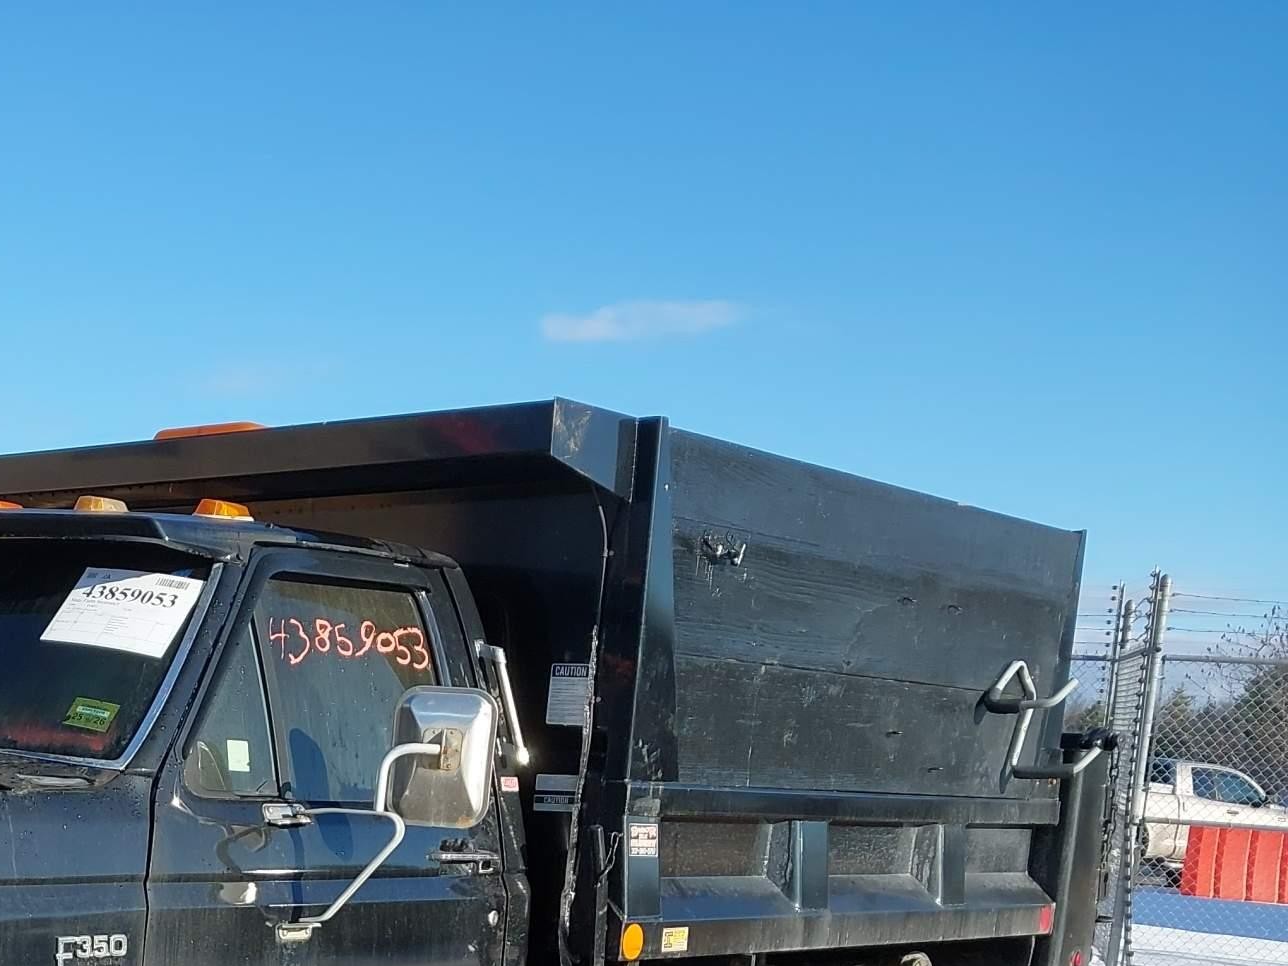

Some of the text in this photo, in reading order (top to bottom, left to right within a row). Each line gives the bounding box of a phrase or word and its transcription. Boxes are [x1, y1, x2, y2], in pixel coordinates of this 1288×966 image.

[82, 584, 179, 608] 43859053
[268, 616, 429, 669] 43859053
[555, 665, 588, 677] CAUTION
